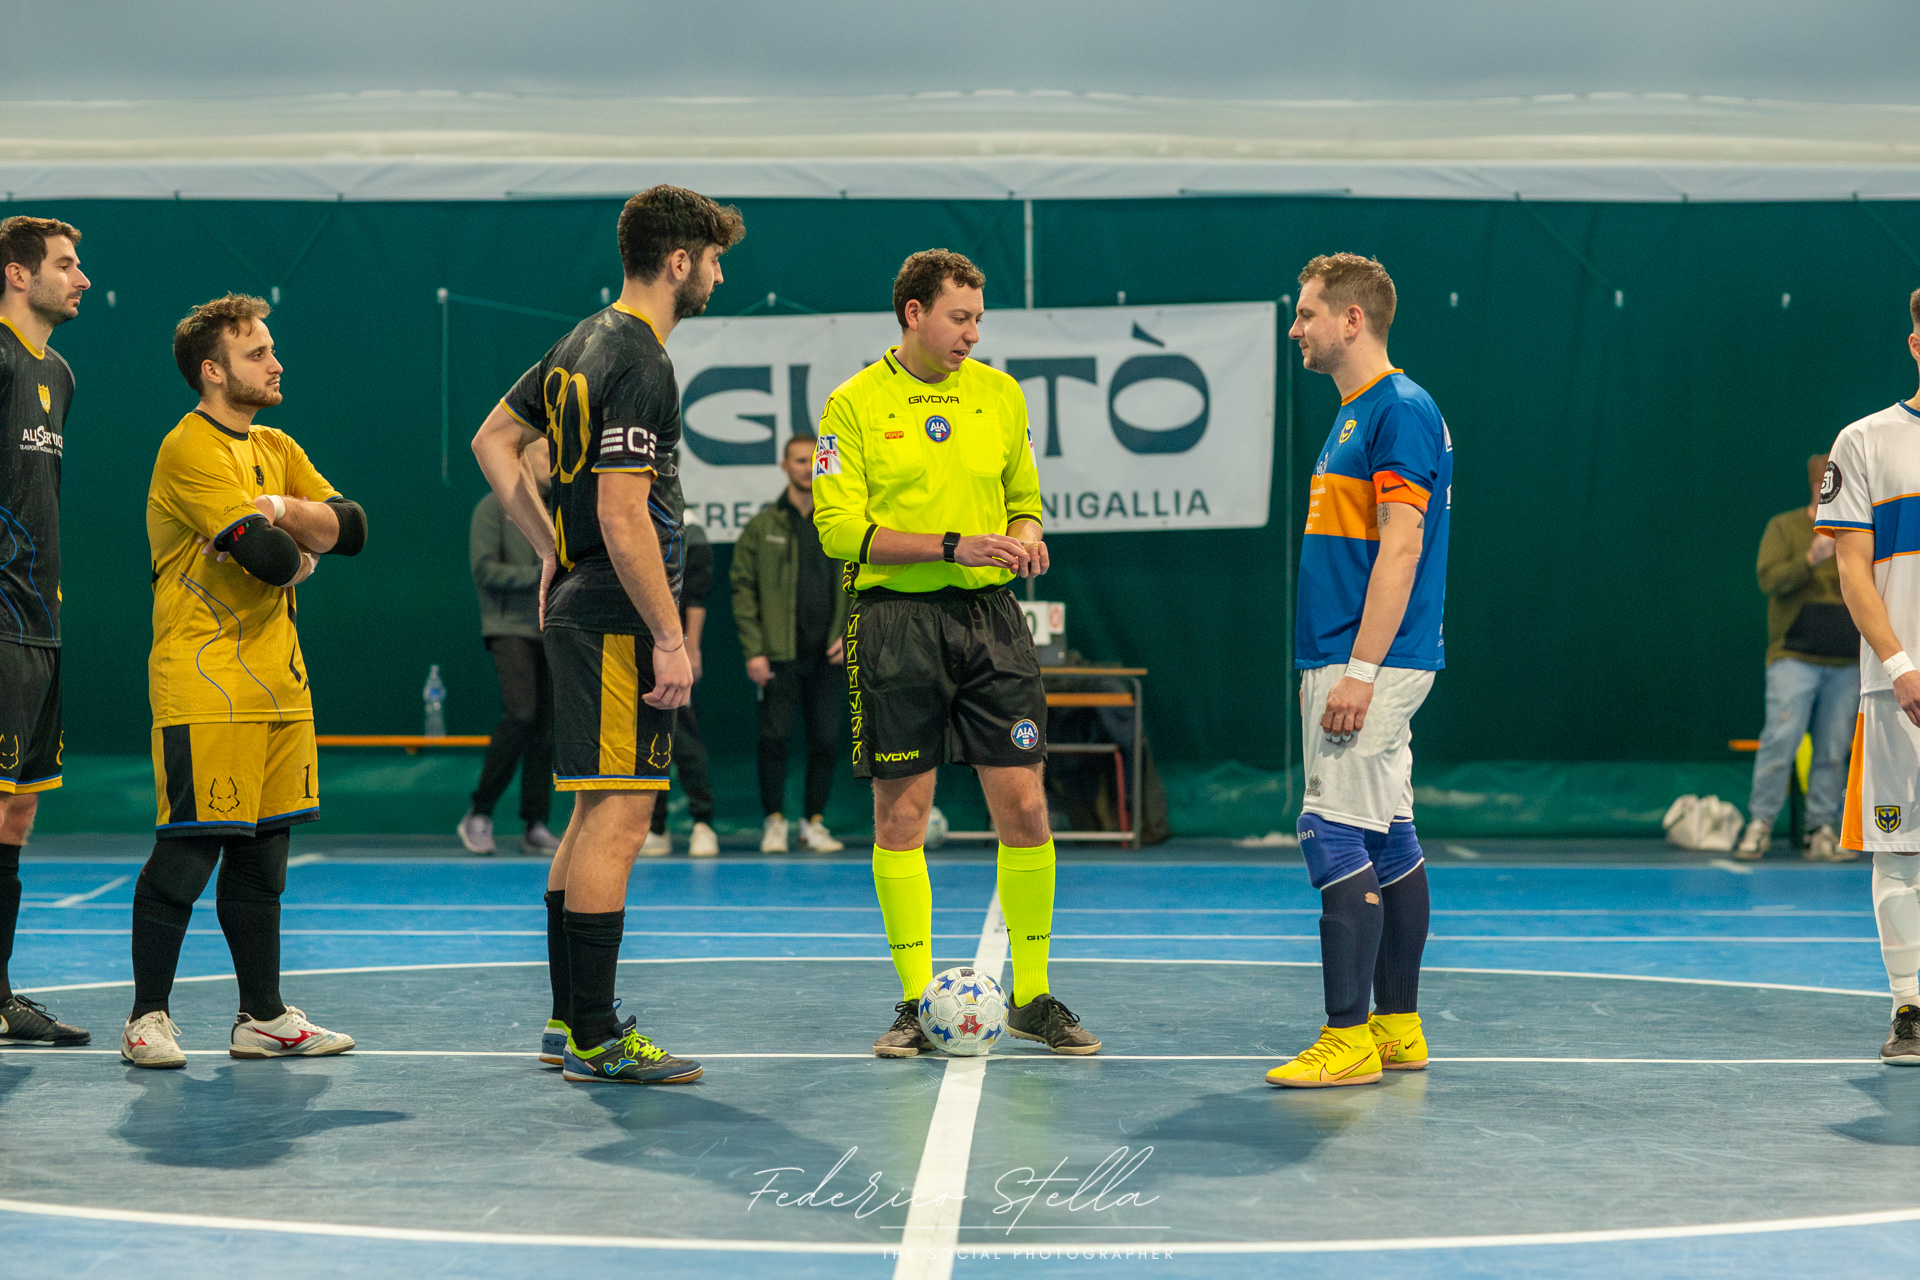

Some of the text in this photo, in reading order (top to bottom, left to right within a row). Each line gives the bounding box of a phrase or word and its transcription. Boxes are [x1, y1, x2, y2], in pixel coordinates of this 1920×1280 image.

[908, 394, 960, 405] GIVOVA
[930, 421, 948, 432] AIA
[1040, 488, 1211, 520] NIGALLIA
[1016, 727, 1035, 739] AIA
[302, 763, 319, 799] 1
